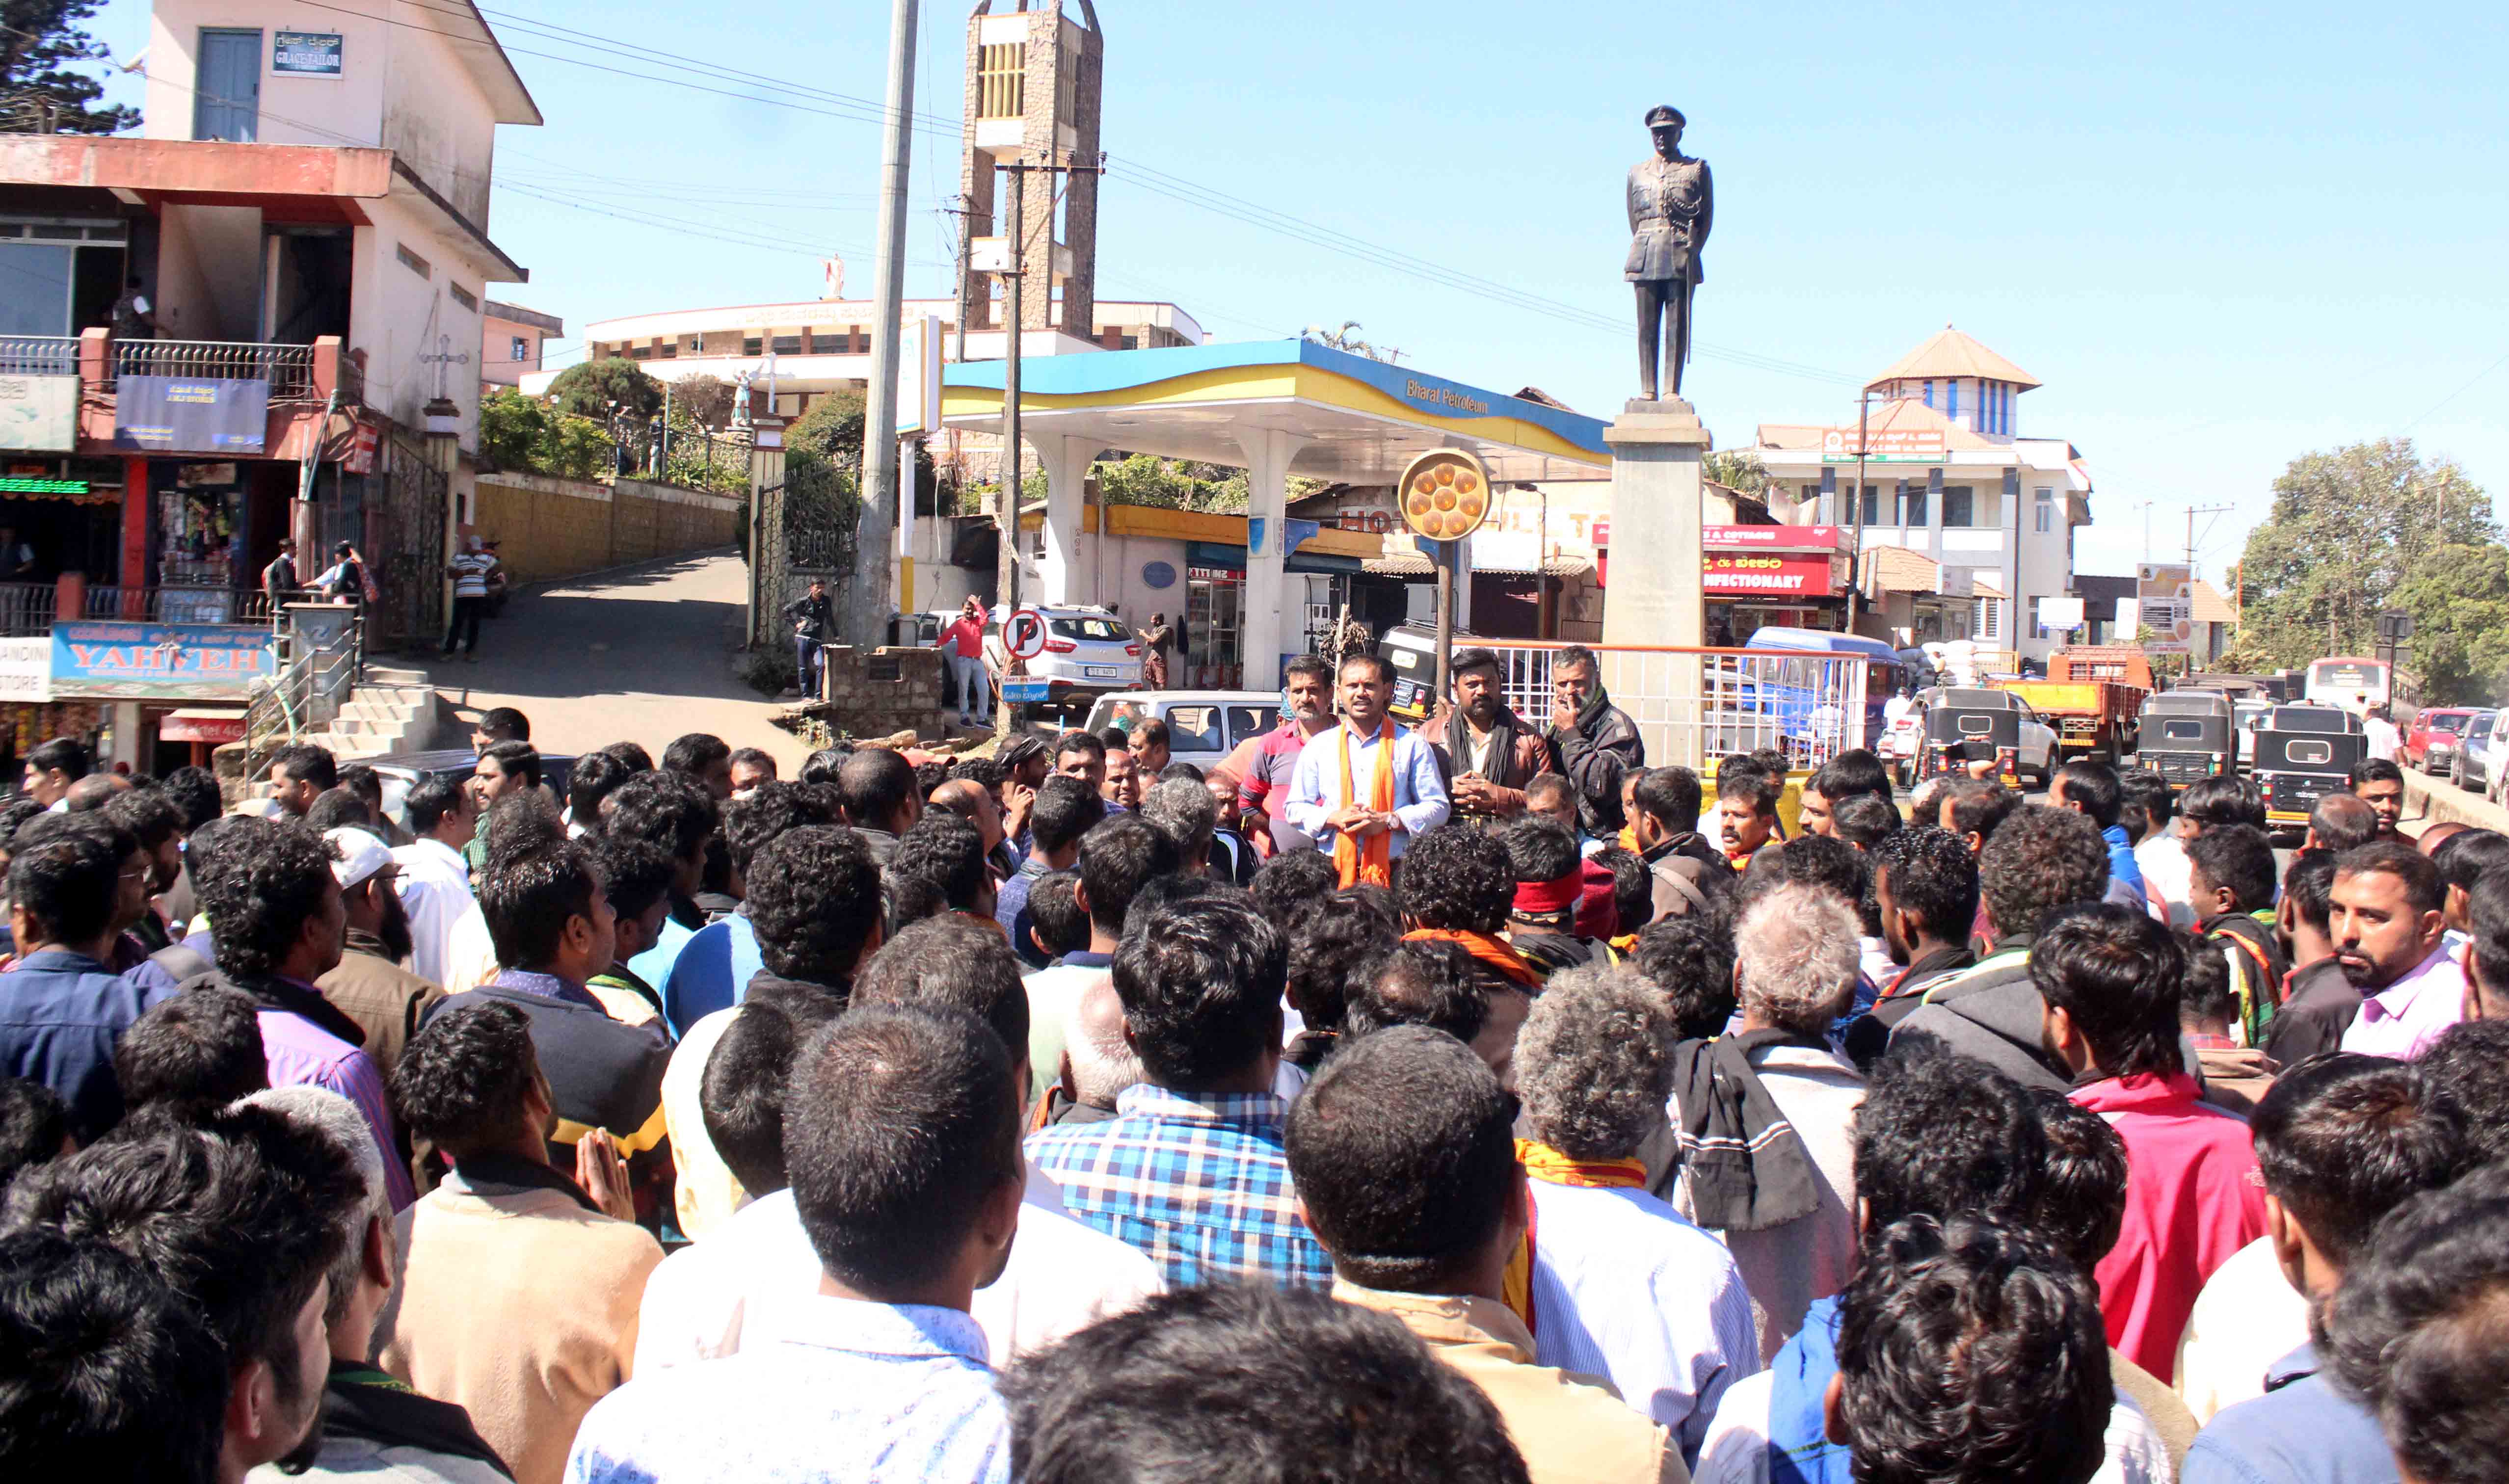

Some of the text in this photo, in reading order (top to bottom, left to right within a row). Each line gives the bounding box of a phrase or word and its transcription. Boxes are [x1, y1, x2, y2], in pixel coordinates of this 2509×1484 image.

[276, 52, 340, 67] GRACE TAILOR
[1406, 379, 1489, 414] Bharat Petroleum
[1704, 574, 1804, 588] NFECTIONARY
[1016, 618, 1038, 651] P
[222, 724, 243, 737] 4G
